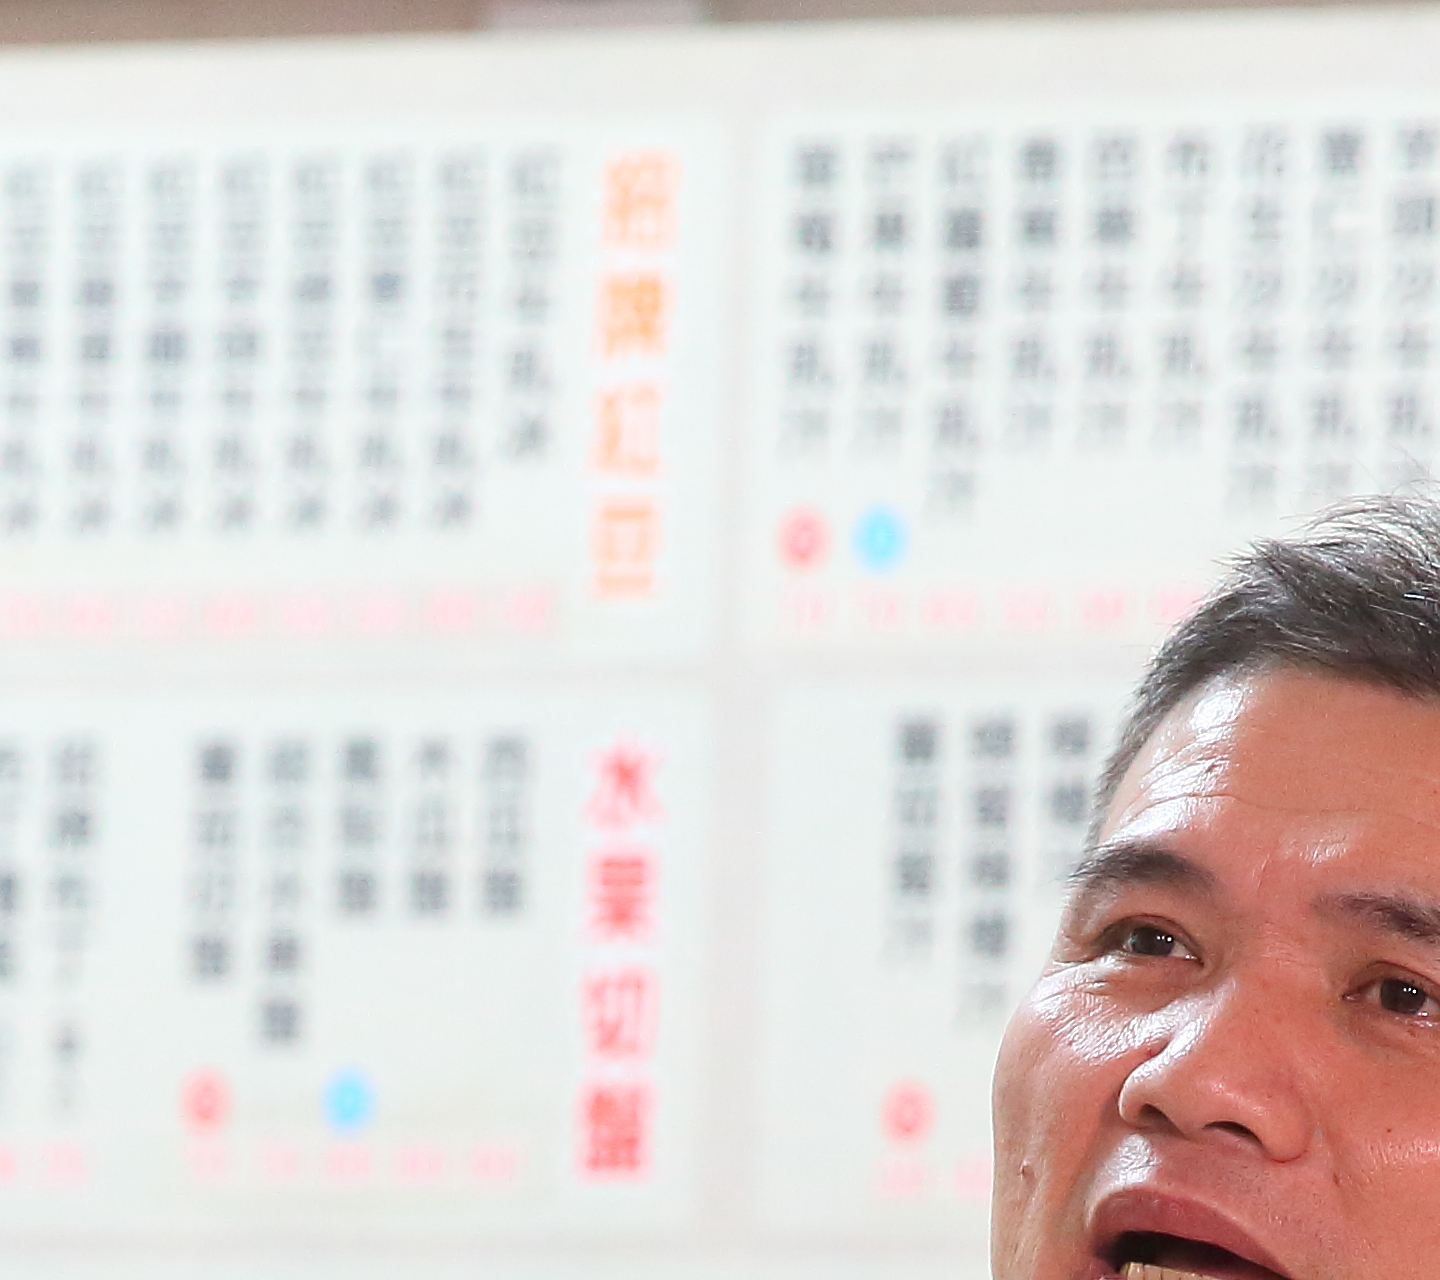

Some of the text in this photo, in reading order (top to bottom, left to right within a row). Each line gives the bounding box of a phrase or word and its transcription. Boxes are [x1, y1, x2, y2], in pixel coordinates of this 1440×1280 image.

[586, 146, 684, 600] 招牌紅豆
[572, 724, 669, 1181] 水果切盤
